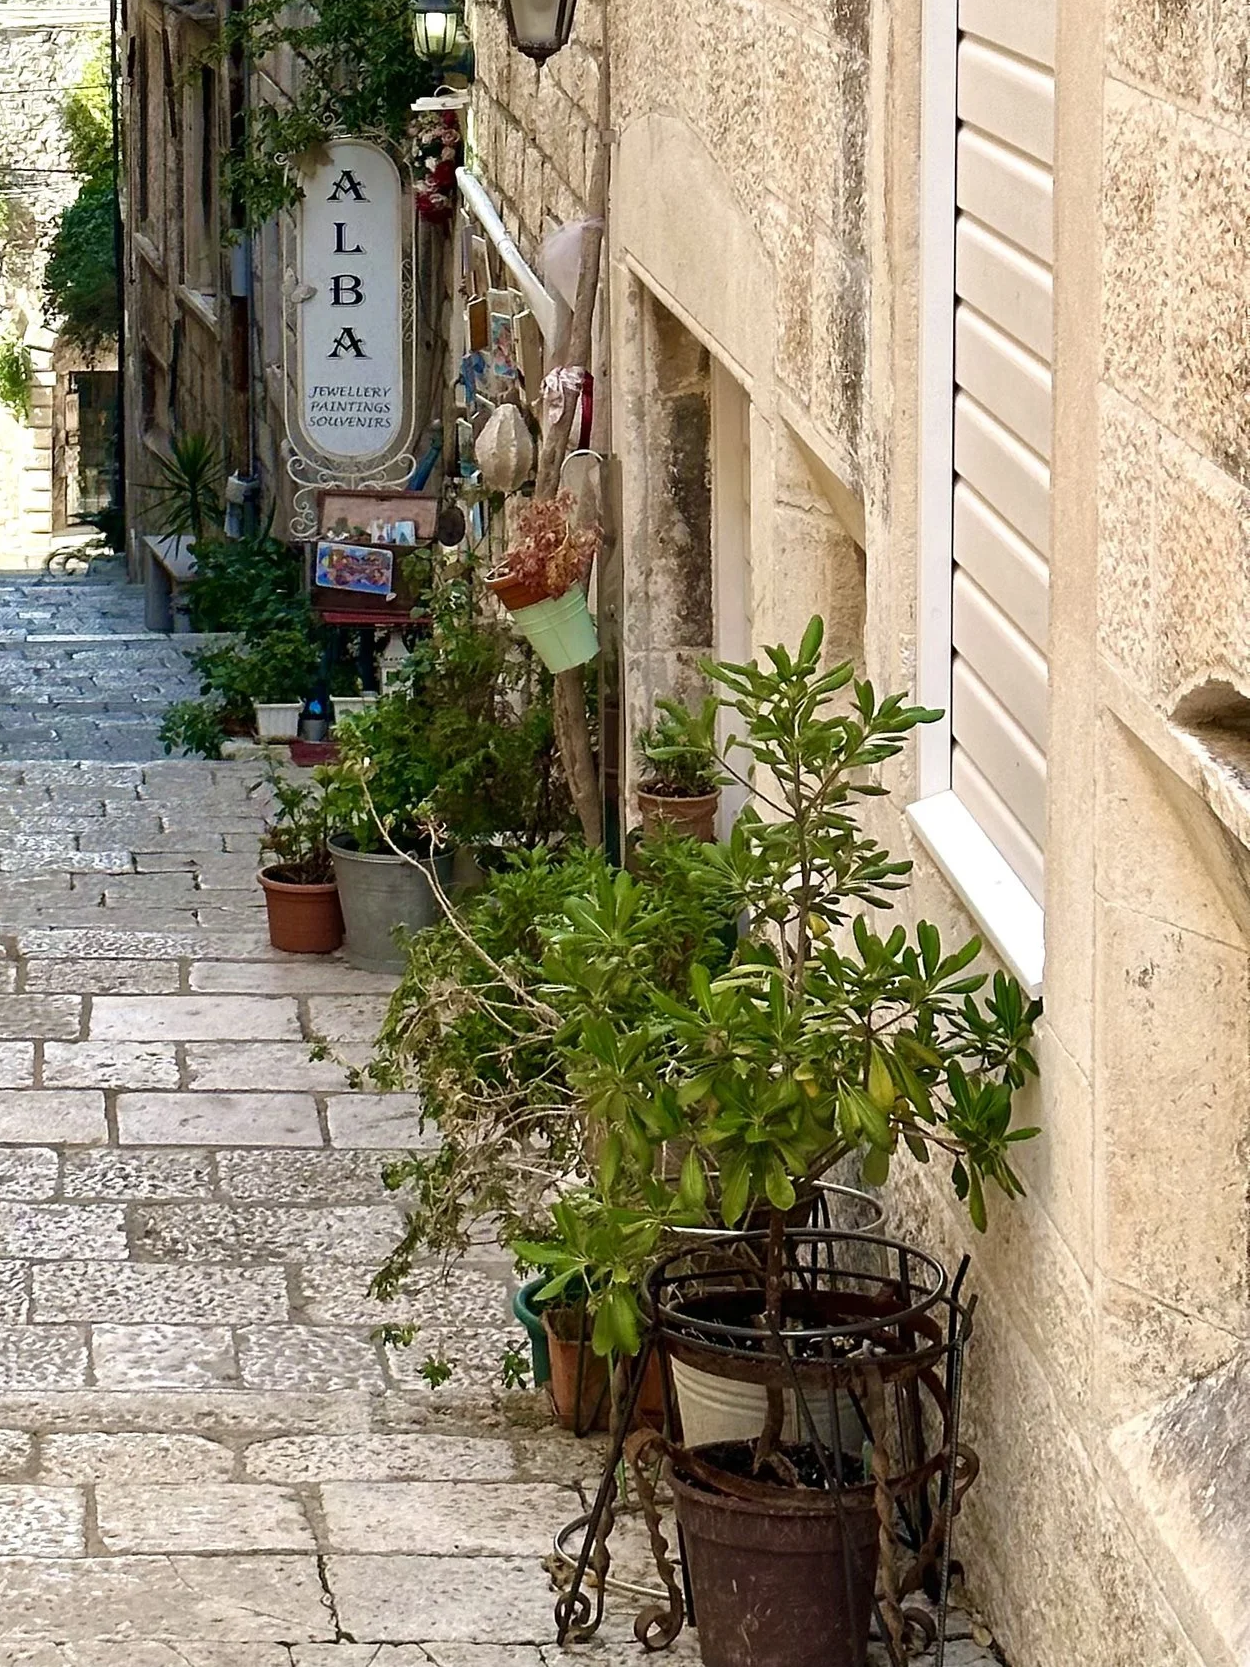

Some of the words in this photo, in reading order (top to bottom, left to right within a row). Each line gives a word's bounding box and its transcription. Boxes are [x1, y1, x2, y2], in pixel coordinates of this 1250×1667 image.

[326, 170, 370, 359] ALBA
[308, 385, 391, 399] JEWELLERY
[310, 400, 391, 414] PAINTINGS
[308, 415, 392, 429] SOUVENIRS
